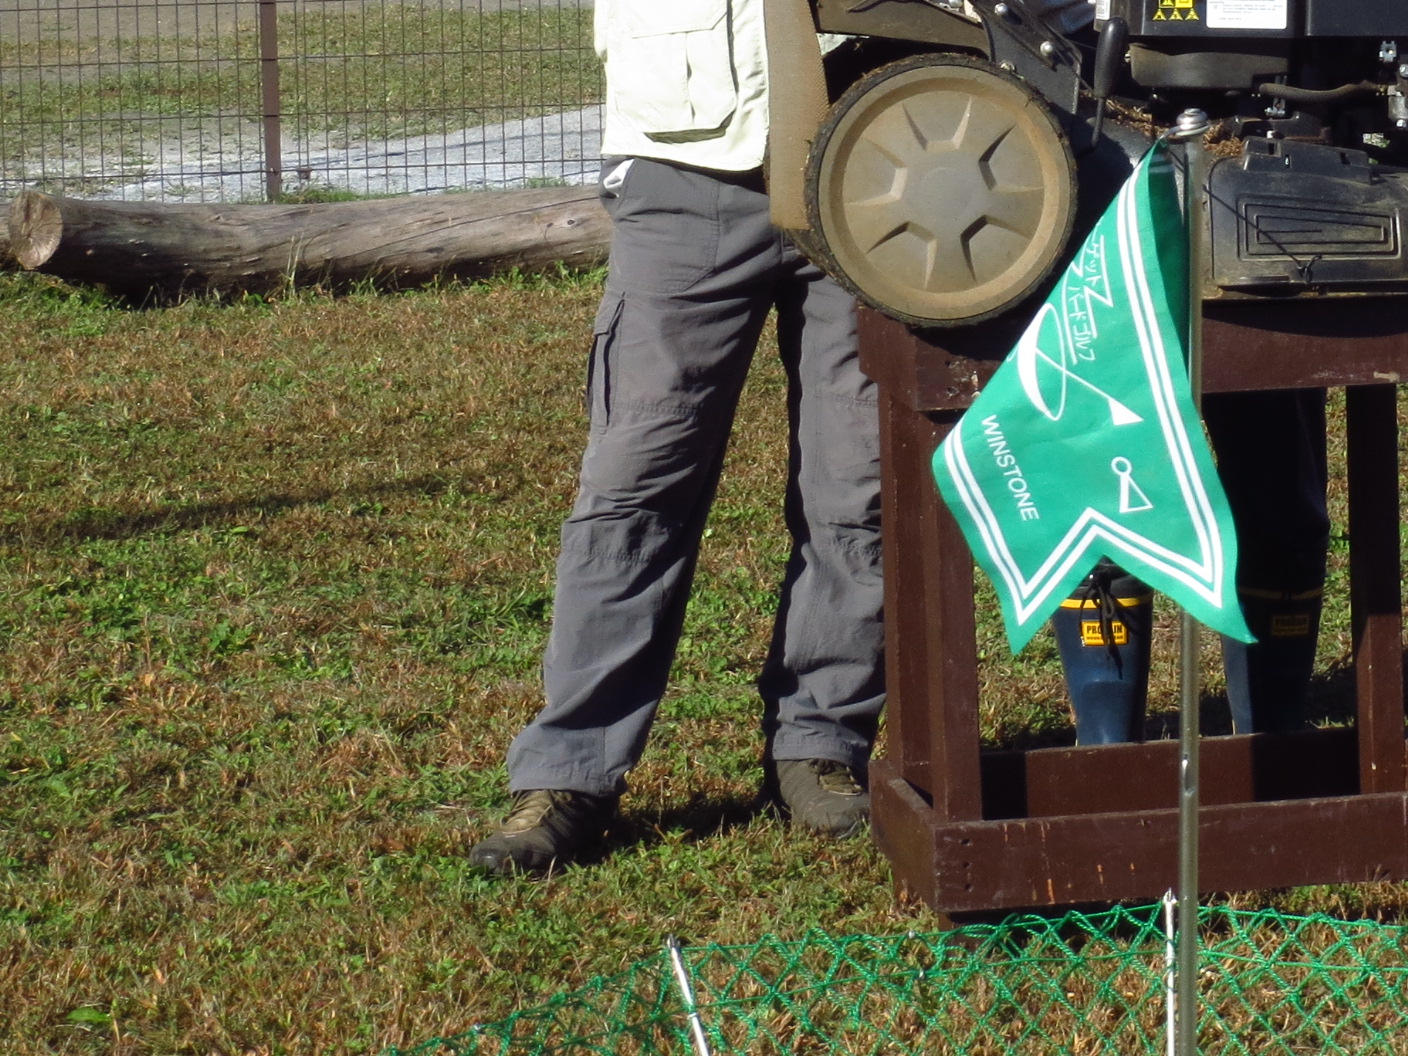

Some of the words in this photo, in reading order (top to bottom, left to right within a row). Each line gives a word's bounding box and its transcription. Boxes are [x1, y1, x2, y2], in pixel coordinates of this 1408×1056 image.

[1085, 217, 1103, 287] ーゲット
[1067, 286, 1096, 362] バードゴルフ
[980, 414, 1040, 521] WINSTONE
